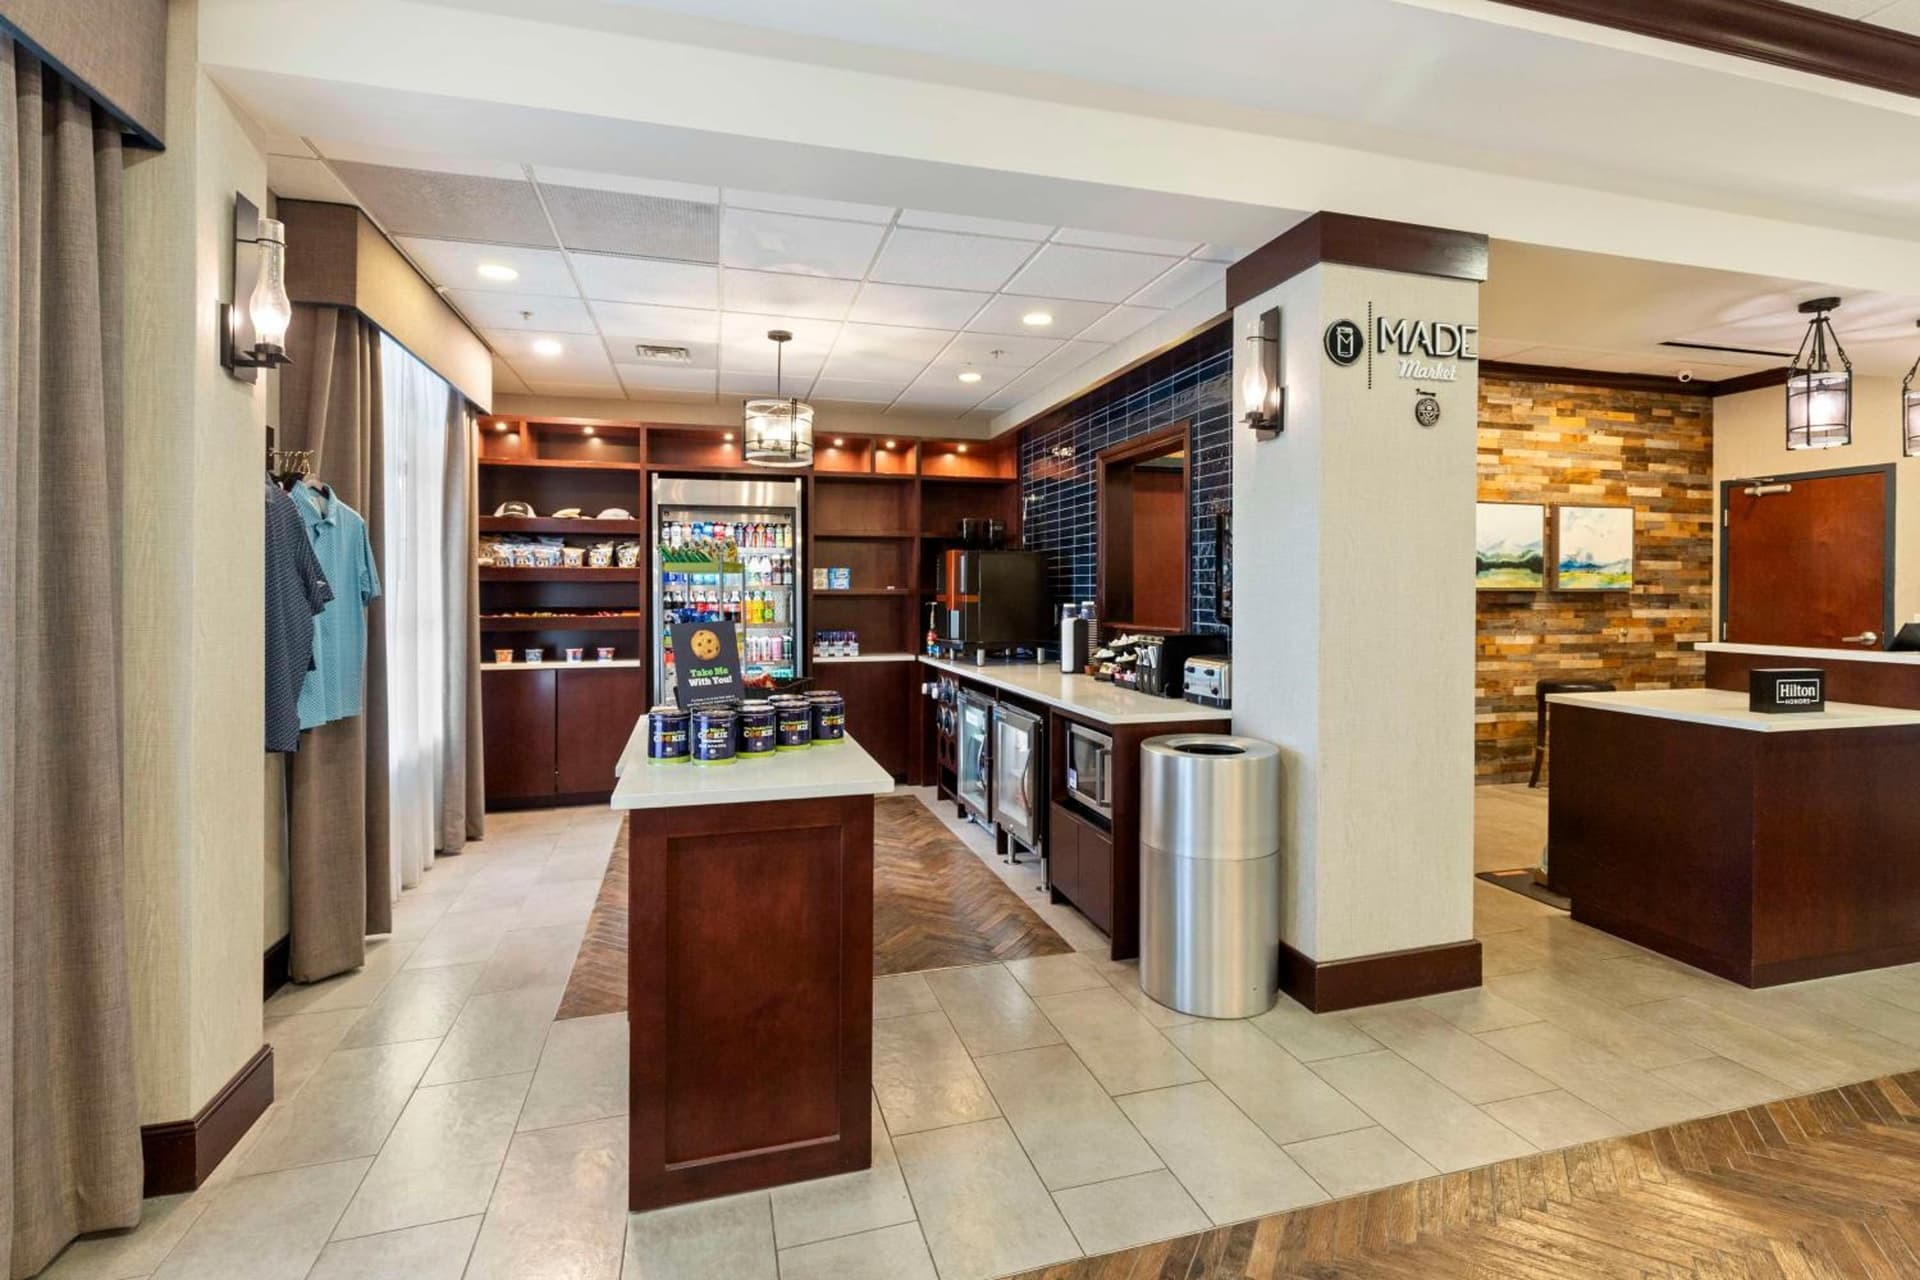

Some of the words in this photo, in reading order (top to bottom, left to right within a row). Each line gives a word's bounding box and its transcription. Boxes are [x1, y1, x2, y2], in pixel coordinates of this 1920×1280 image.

[1377, 317, 1479, 360] MADE
[1400, 360, 1456, 381] Market
[690, 668, 713, 677] Take
[714, 666, 729, 675] Me
[688, 677, 712, 687] With
[712, 675, 733, 685] You!
[1780, 684, 1816, 697] Hilton
